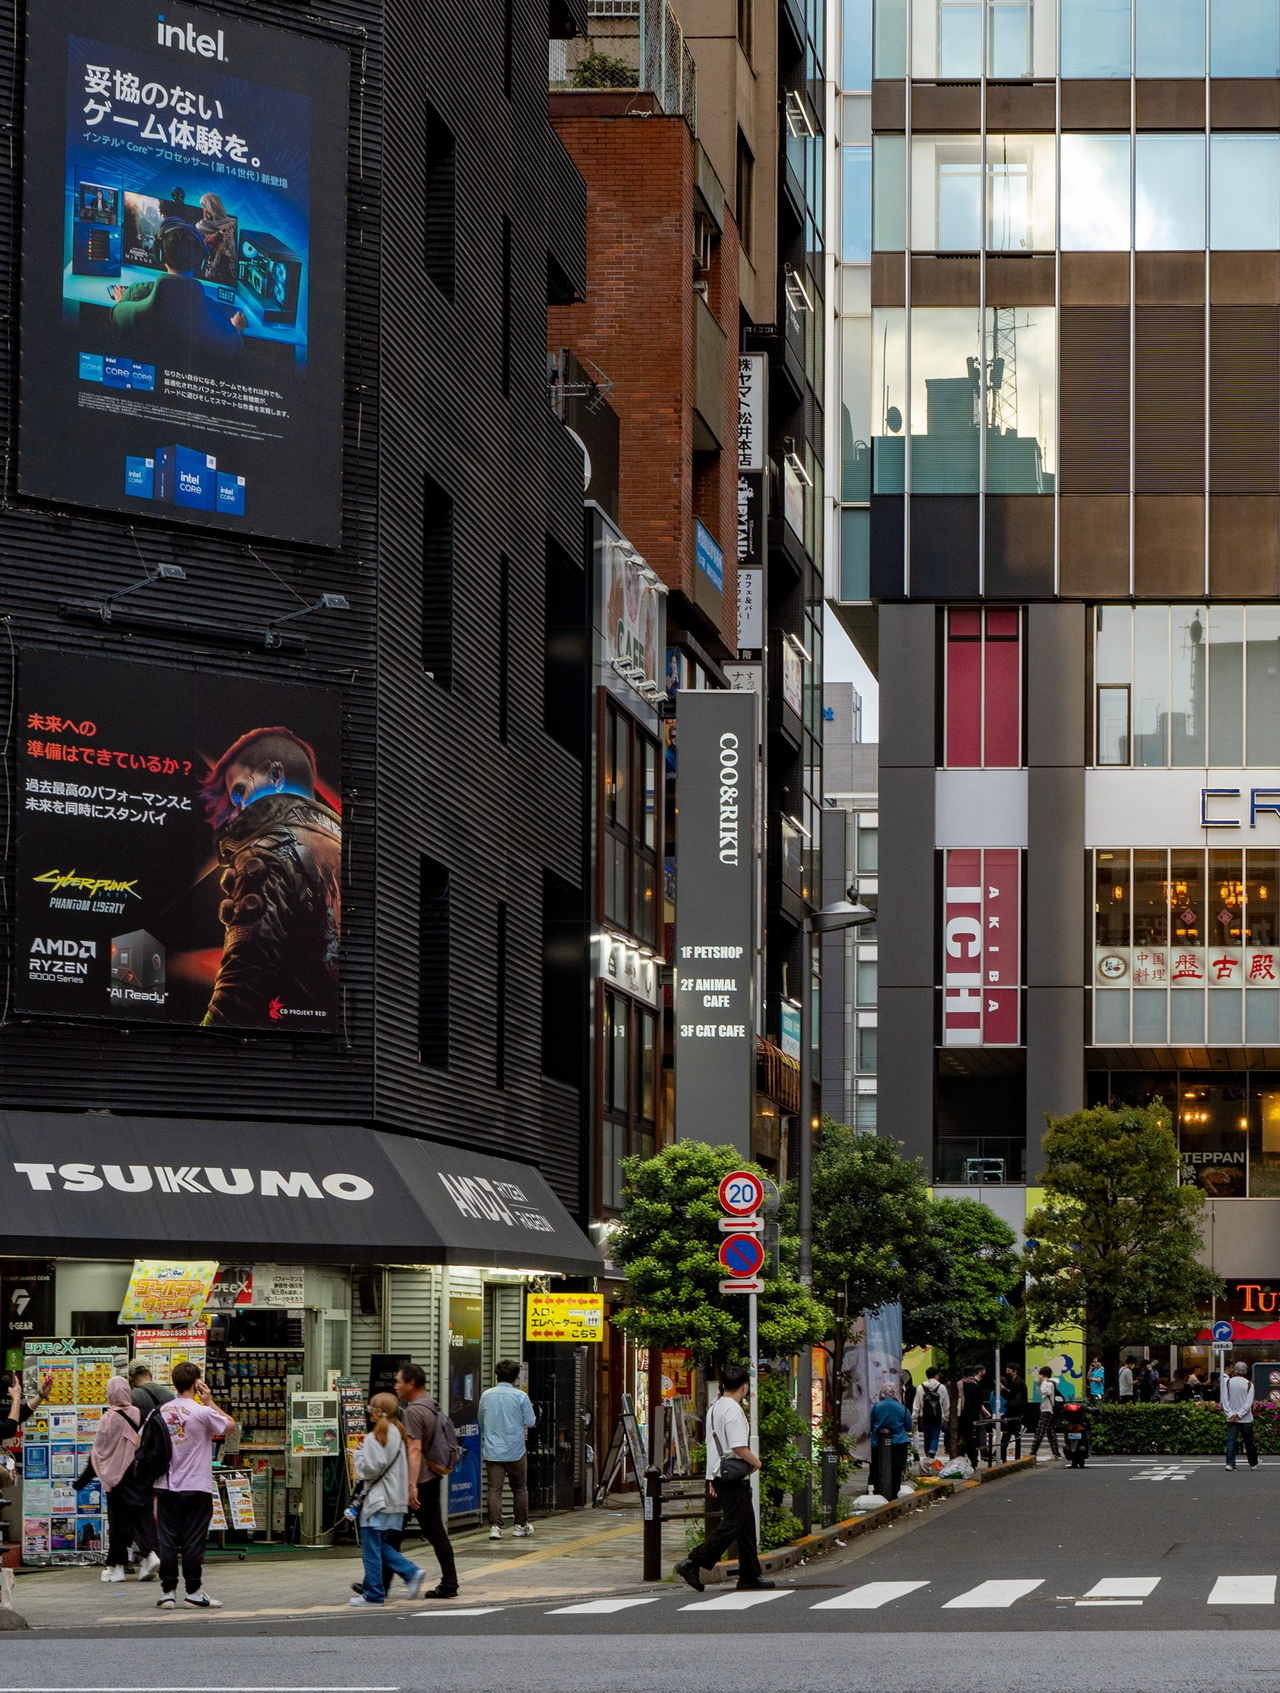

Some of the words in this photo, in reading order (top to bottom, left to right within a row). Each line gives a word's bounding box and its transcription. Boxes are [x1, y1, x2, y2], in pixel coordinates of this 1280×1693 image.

[157, 14, 229, 62] intel
[84, 63, 224, 120] 妥協のない
[83, 98, 261, 168] ゲーム体験を。
[180, 470, 200, 485] intel
[27, 713, 97, 737] 未来への
[25, 778, 192, 811] 過去最高のパフォーマンスと
[719, 732, 739, 867] COO&RIKU
[25, 797, 167, 826] 未来を同時にスタンバイ
[49, 897, 91, 912] PHANTOM
[30, 937, 79, 957] AMD
[681, 946, 693, 959] 1F
[694, 946, 744, 959] PETSHOP
[988, 886, 1000, 1013] AKIBA
[29, 958, 88, 975] RYZEN
[946, 886, 982, 1044] ICHI
[57, 975, 84, 984] Series
[681, 979, 694, 991] 2F
[695, 979, 737, 991] ANIMAL
[703, 995, 730, 1007] CAFE
[289, 1008, 313, 1016] PROJEKT
[681, 1025, 694, 1037] 3F
[695, 1025, 717, 1037] CAT
[720, 1025, 745, 1037] CAFE
[1182, 1152, 1245, 1163] TEPPAN
[14, 1163, 374, 1200] TSUKUMO
[437, 1172, 503, 1222] AMD
[729, 1184, 754, 1203] 20
[531, 1318, 583, 1328] エレベーターは
[571, 1329, 597, 1339] こちら
